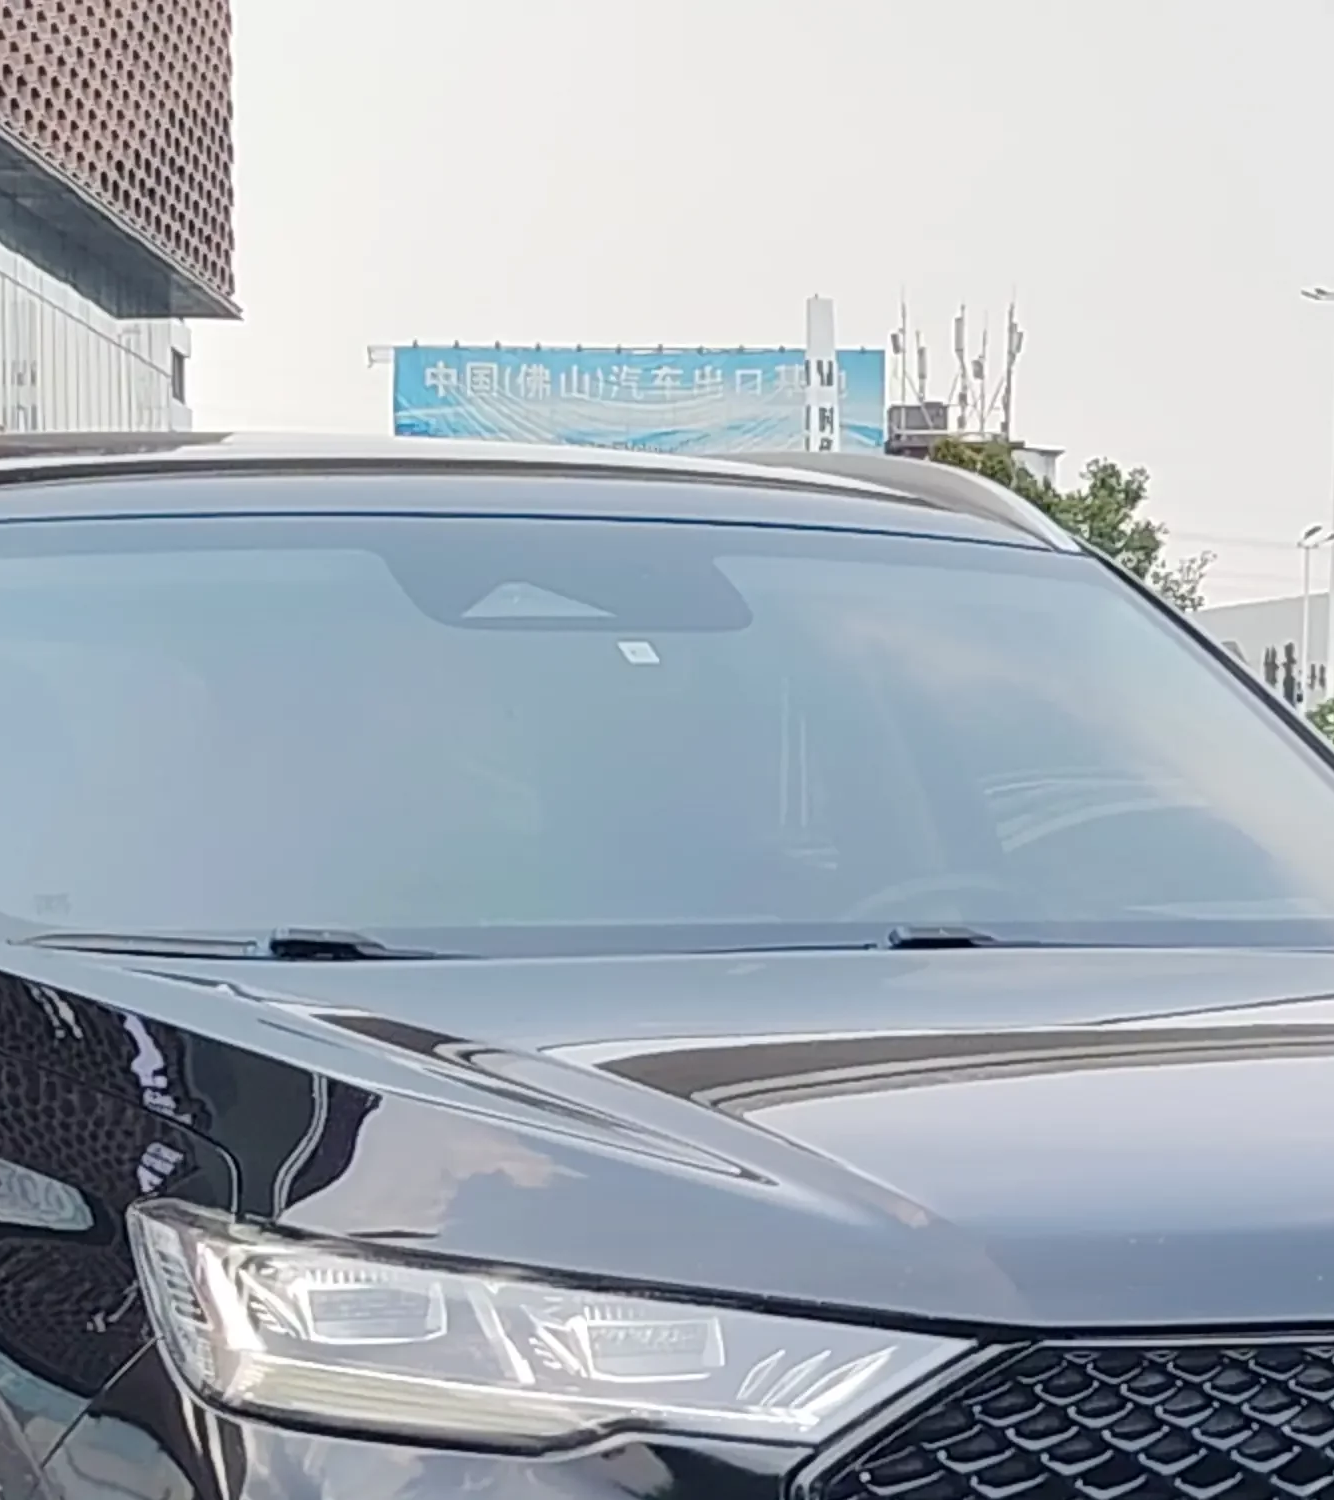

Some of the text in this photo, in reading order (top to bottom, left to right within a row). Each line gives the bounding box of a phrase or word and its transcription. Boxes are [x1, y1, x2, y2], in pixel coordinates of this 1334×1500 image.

[424, 361, 848, 402] 中国(佛山)汽车出口基
